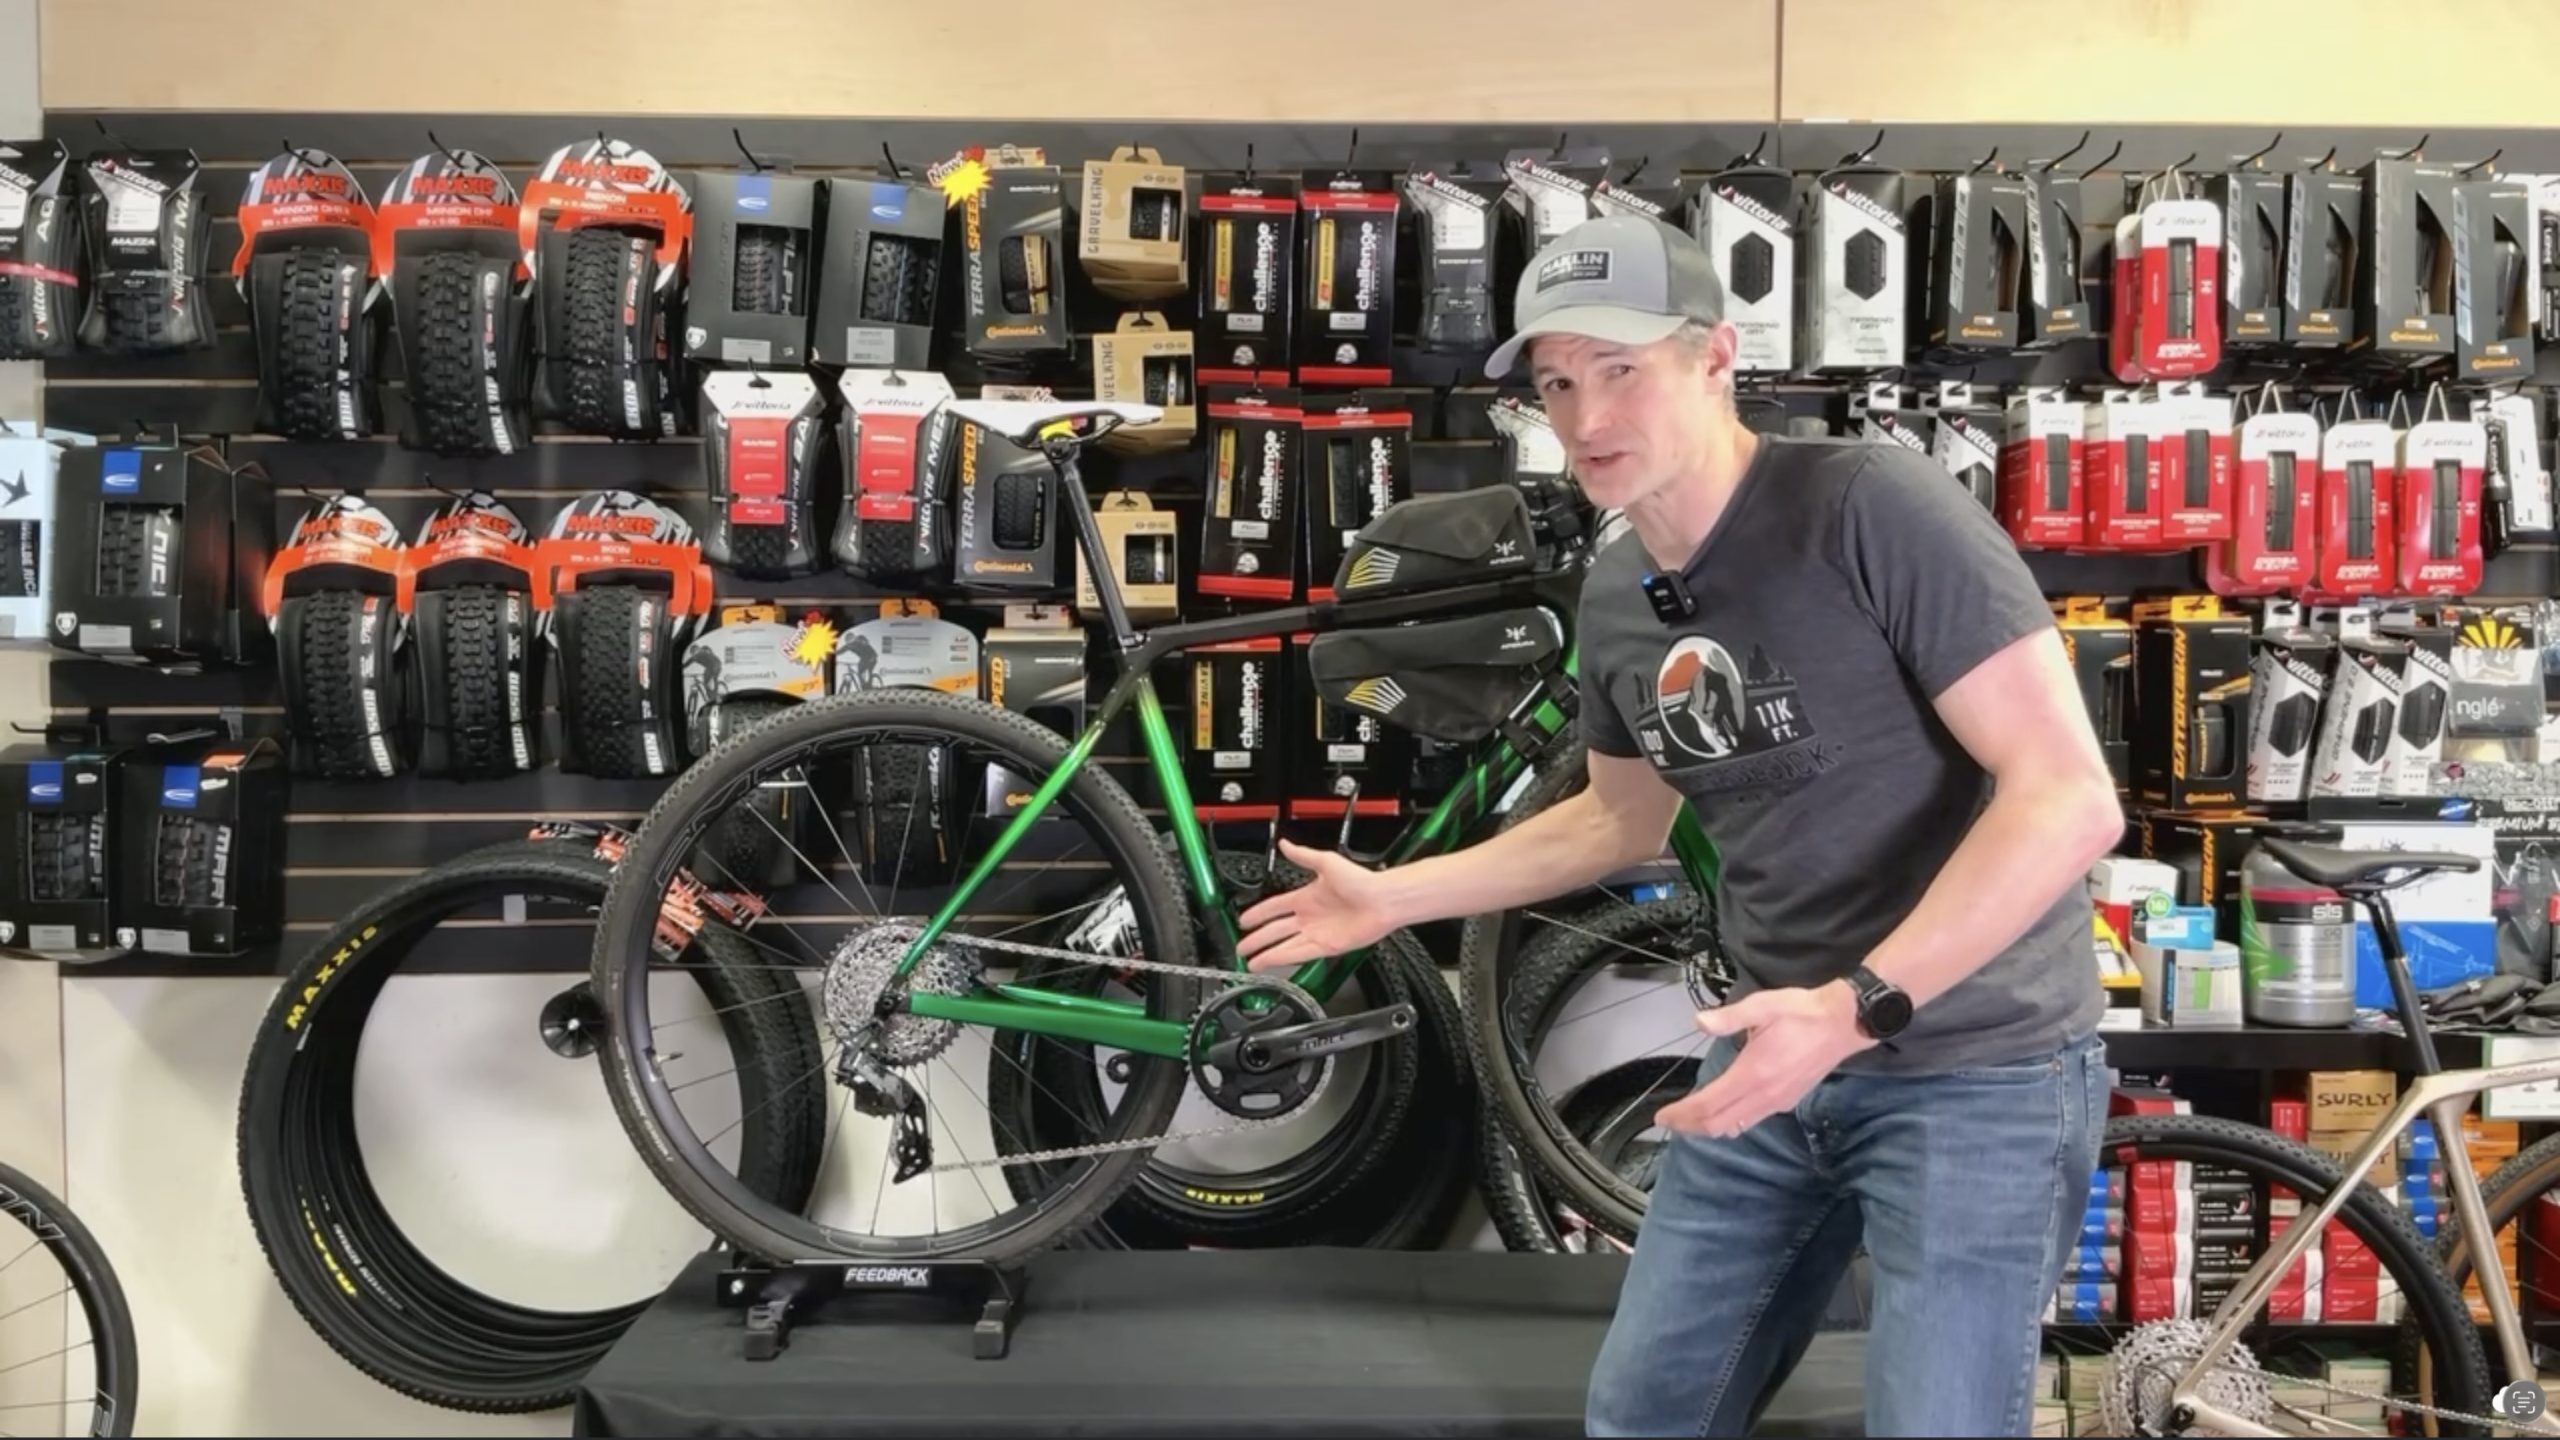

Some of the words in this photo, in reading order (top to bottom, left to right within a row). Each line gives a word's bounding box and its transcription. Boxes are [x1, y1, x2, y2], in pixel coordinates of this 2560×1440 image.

[114, 166, 171, 192] vittoria
[264, 176, 347, 195] MAXXIS
[412, 177, 494, 194] MAXXIS
[559, 160, 650, 183] MAXXIS
[1532, 165, 1590, 192] vittoria
[1434, 180, 1490, 207] vittoria
[1608, 185, 1665, 215] vittoria
[1845, 189, 1903, 227] vittoria
[1087, 168, 1103, 254] GRAVELKING
[1732, 191, 1791, 231] vittoria
[1253, 222, 1274, 312] challenge
[1356, 221, 1377, 311] challenge
[1258, 430, 1281, 520] challenge
[1369, 437, 1388, 520] hallenge
[569, 515, 657, 535] MAXXIS
[1239, 661, 1259, 748] challenge
[1755, 697, 1795, 728] 11K
[1772, 724, 1799, 743] FT.
[285, 925, 378, 1030] MAXXIS
[2317, 1092, 2392, 1108] SURLY
[845, 1267, 929, 1282] FEEDBACK
